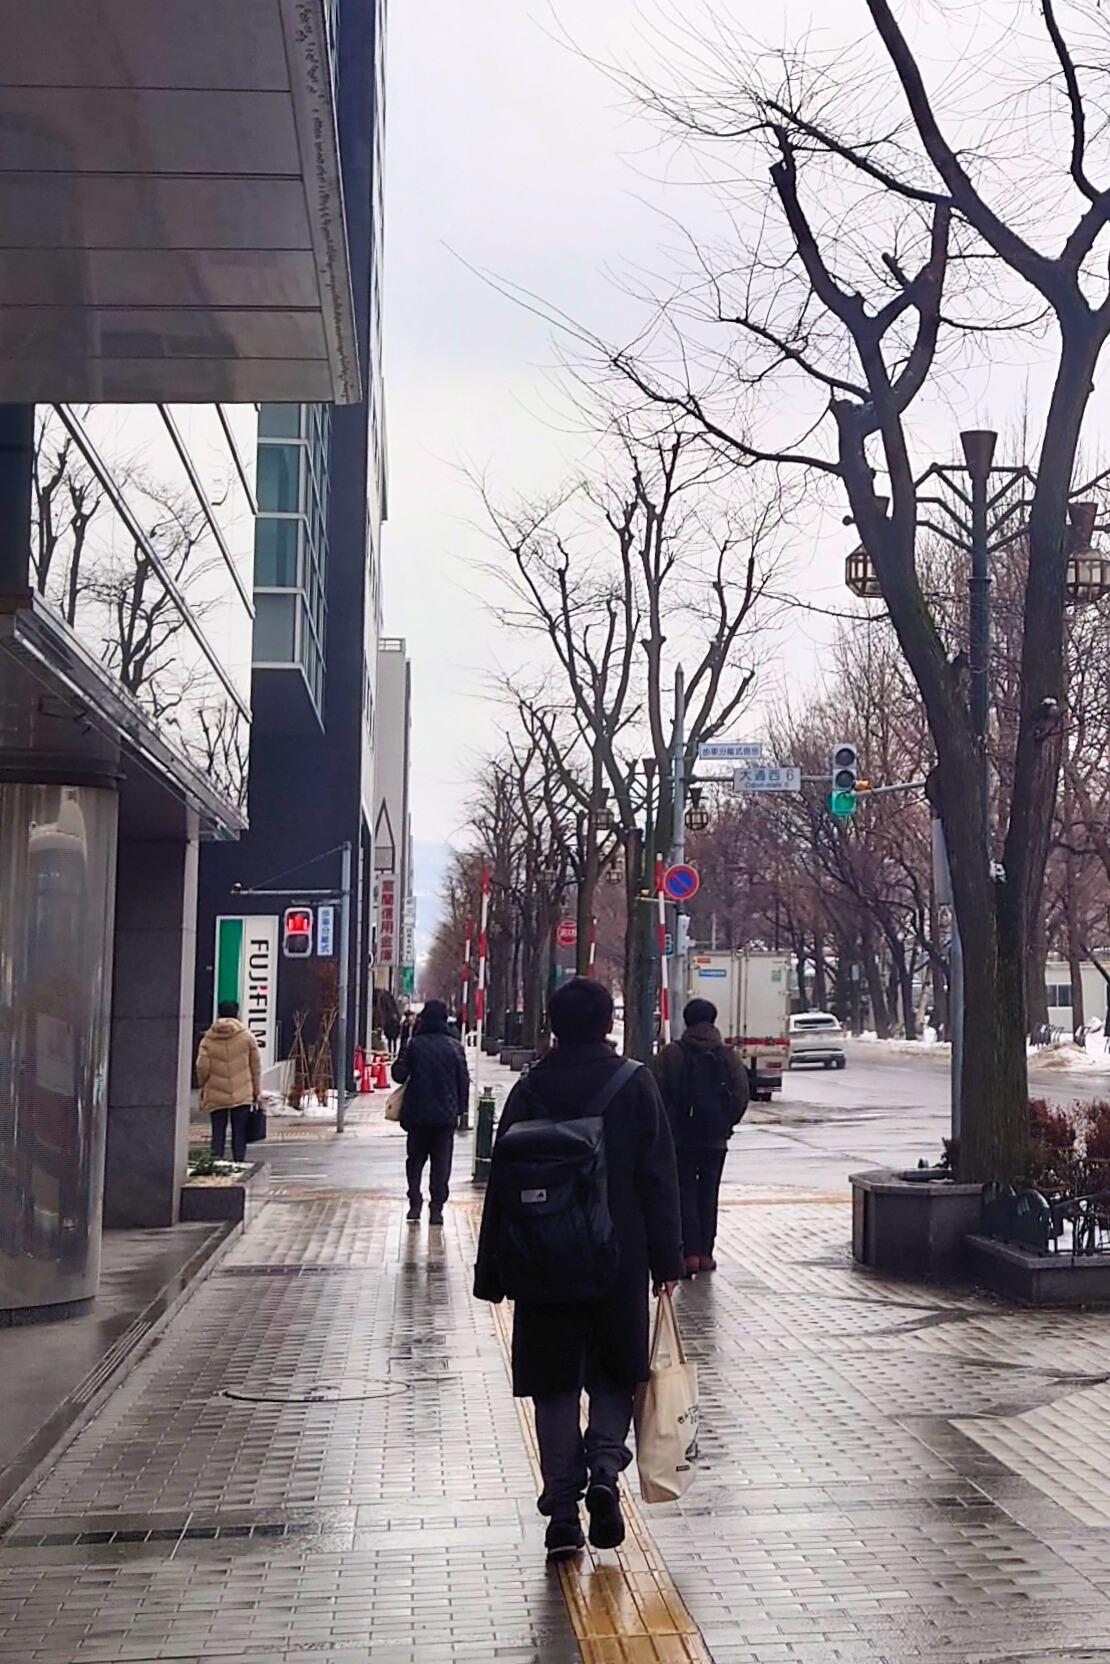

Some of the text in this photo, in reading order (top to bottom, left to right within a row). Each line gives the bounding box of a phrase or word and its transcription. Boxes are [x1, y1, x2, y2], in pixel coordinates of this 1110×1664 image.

[740, 769, 795, 781] 大通西 6
[381, 880, 394, 961] 室蘭信用金庫
[248, 939, 269, 1048] FUJIFILM
